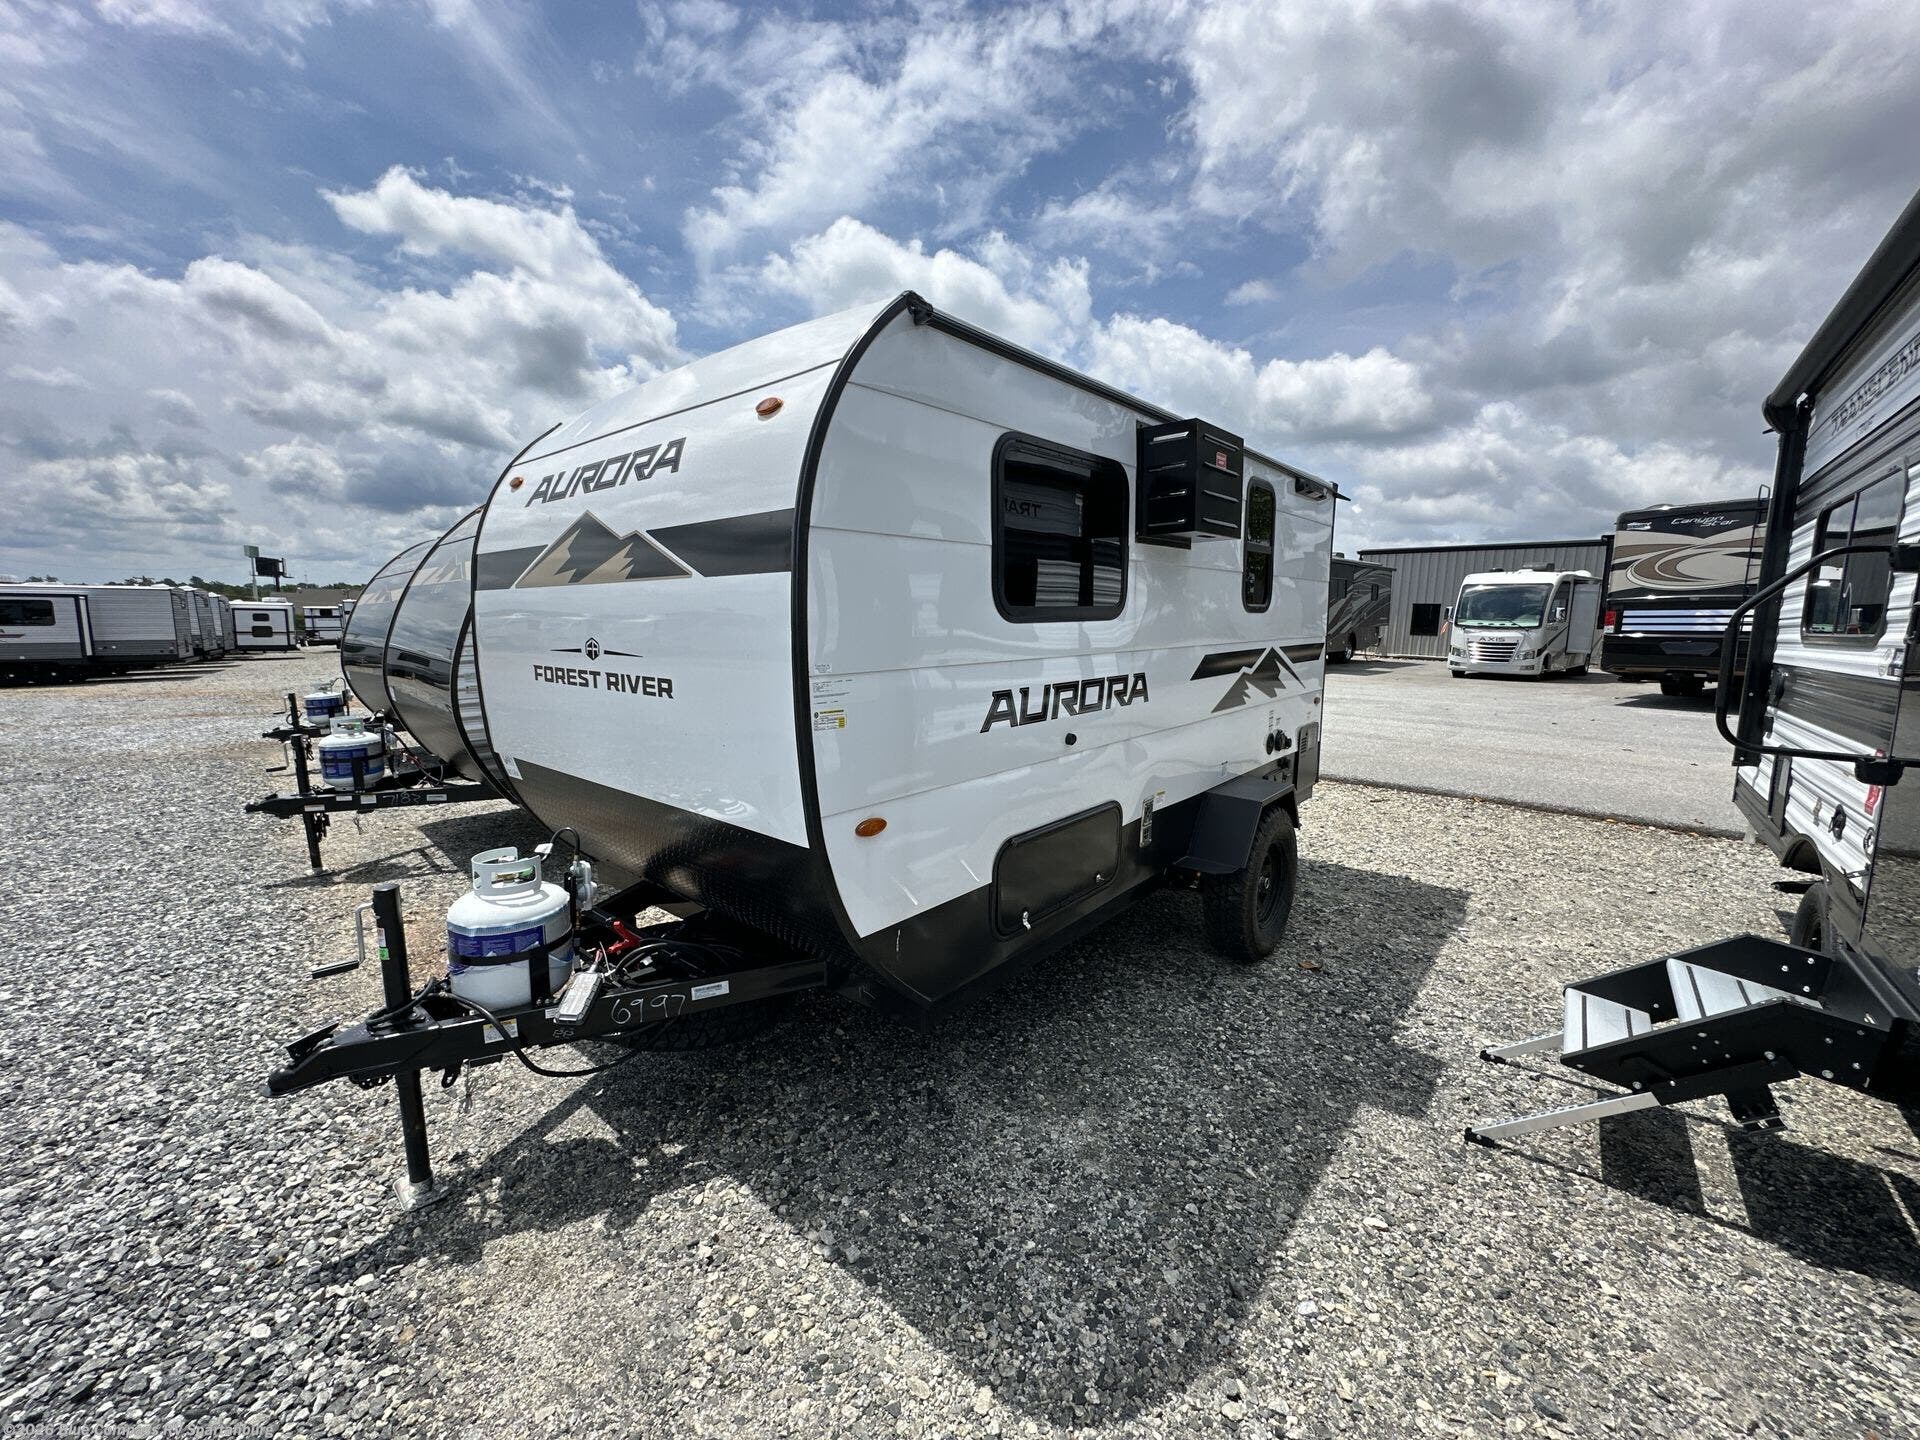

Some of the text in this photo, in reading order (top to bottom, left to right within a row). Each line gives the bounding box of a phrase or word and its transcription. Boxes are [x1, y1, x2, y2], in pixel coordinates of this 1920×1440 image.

[525, 437, 687, 507] AURORA
[1671, 516, 1724, 525] Canyon
[1700, 519, 1740, 527] Star
[533, 664, 674, 699] FOREST RIVER
[979, 672, 1149, 734] AURORA
[611, 994, 686, 1024] 6997
